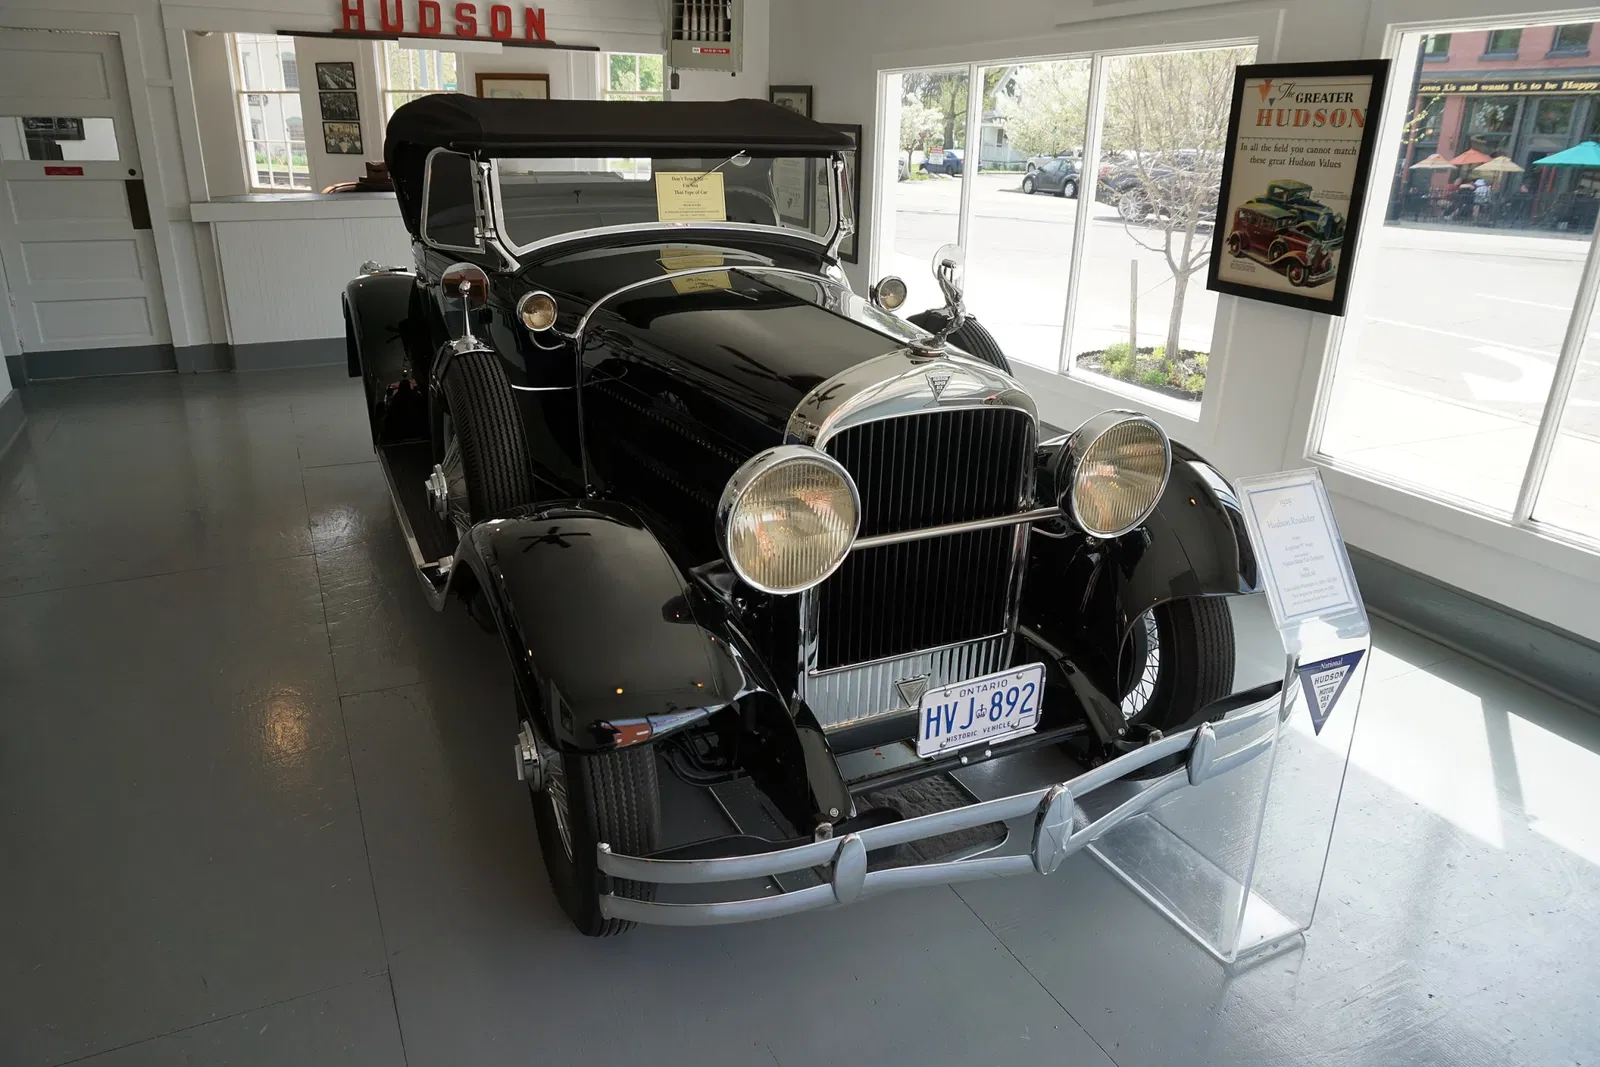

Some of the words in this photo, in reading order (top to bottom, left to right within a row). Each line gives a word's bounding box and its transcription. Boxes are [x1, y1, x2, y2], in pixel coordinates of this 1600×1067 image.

[341, 0, 546, 41] HUDSON
[1278, 82, 1296, 101] The
[1295, 92, 1354, 103] GREATER
[1442, 83, 1457, 92] Us
[1459, 83, 1479, 92] and
[1481, 83, 1510, 92] wants
[1513, 82, 1527, 91] Us
[1530, 82, 1542, 91] to
[1544, 81, 1558, 90] be
[1256, 108, 1368, 128] HUDSON
[1240, 142, 1248, 151] In
[1250, 143, 1259, 152] all
[1261, 143, 1272, 153] the
[1274, 144, 1289, 153] field
[1290, 146, 1304, 156] you
[1306, 147, 1331, 155] cannot
[1334, 146, 1357, 156] match
[1249, 156, 1266, 165] these
[1268, 158, 1286, 167] great
[1288, 156, 1316, 167] Hudson
[1319, 158, 1342, 168] Values
[1266, 516, 1290, 529] Hudson
[1314, 670, 1345, 685] HUDSON
[959, 679, 1008, 698] ONTARIO
[1319, 686, 1335, 696] MOTOR
[1320, 695, 1330, 703] CAR
[925, 697, 975, 740] HVJ
[989, 682, 1035, 722] 892
[946, 731, 978, 743] HISTORIC
[982, 720, 1012, 733] VEHICLE
